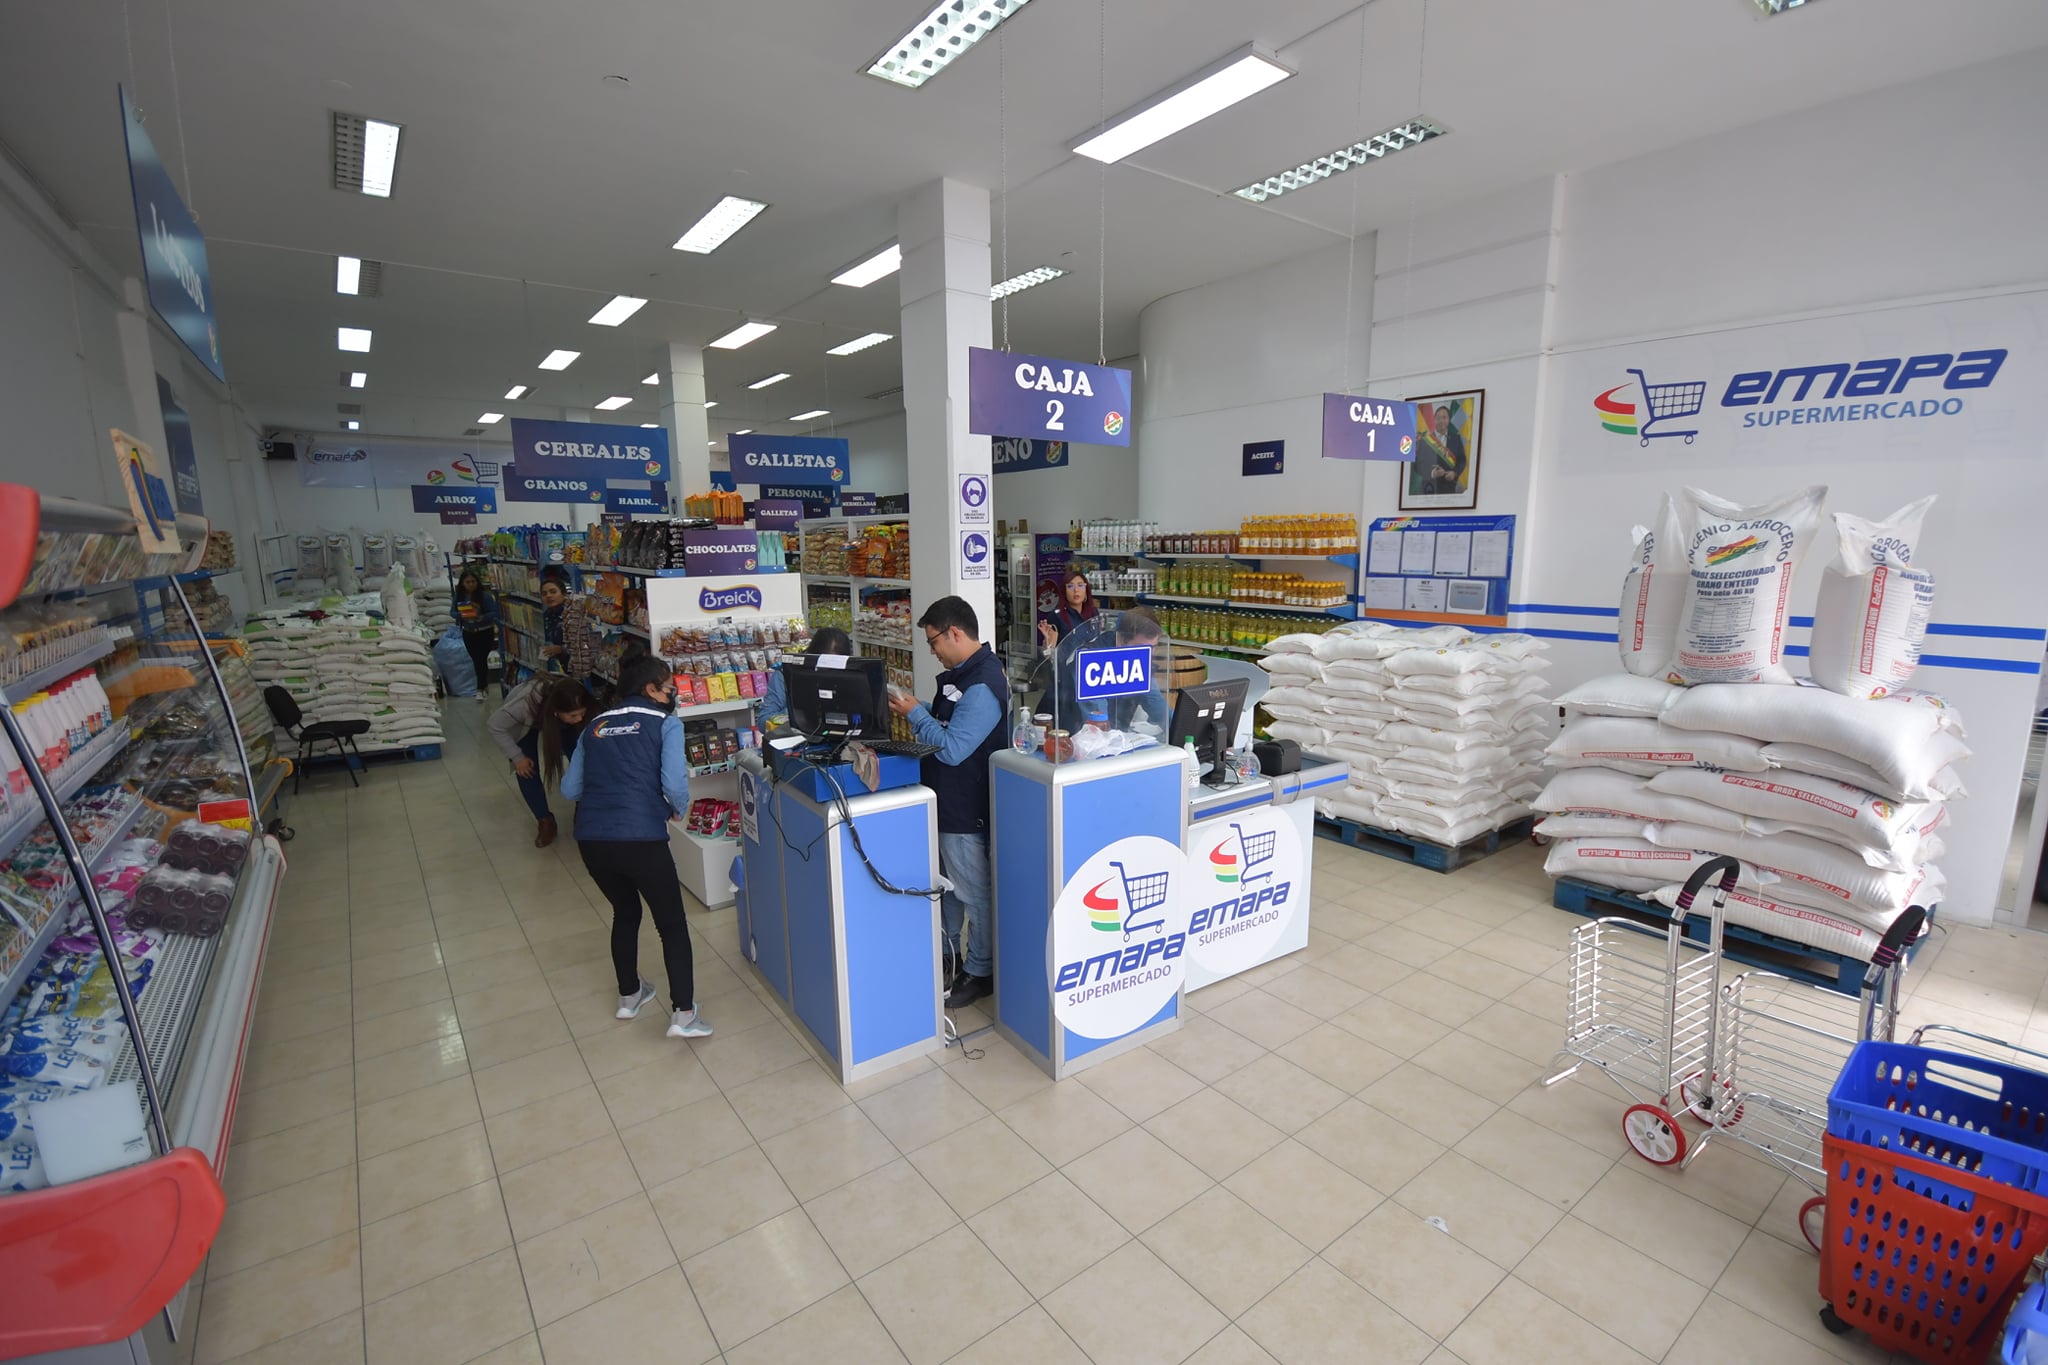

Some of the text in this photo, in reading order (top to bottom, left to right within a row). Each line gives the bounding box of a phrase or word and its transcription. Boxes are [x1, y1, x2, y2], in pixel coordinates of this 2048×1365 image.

[1014, 363, 1094, 397] CAJA
[1720, 349, 2008, 407] emapa
[1046, 399, 1065, 431] 2
[1350, 402, 1396, 426] CAJA
[1743, 397, 1964, 428] SUPERMERCADO
[534, 440, 652, 461] CEREALES
[1366, 429, 1377, 452] 1
[744, 452, 837, 468] GALLETAS
[1251, 451, 1275, 460] ACEITE
[524, 479, 588, 491] GRANOS
[767, 488, 825, 499] PERSONAL
[434, 495, 477, 504] ARROZ
[760, 509, 798, 517] GALLETAS
[685, 543, 757, 554] CHOCOLATES
[1688, 519, 1795, 565] INGENIO ARROCERO
[1696, 577, 1759, 589] GRANO ENTERO
[1709, 565, 1776, 580] SELECCIONADO
[704, 589, 758, 608] Breick
[1085, 658, 1145, 688] CAJA
[1772, 784, 1798, 797] ARROZ
[1797, 791, 1854, 816] SELECCIONADO
[1619, 850, 1640, 858] ARROZ
[1640, 851, 1689, 859] SELECCIONADO
[1188, 881, 1291, 935] emapa
[1774, 905, 1800, 917] ARROZ
[1799, 911, 1860, 934] SELECCIONADO
[1198, 909, 1279, 947] SUPERMERCADO
[1054, 931, 1186, 993] emapa
[1068, 964, 1172, 1007] SUPERMERCADO
